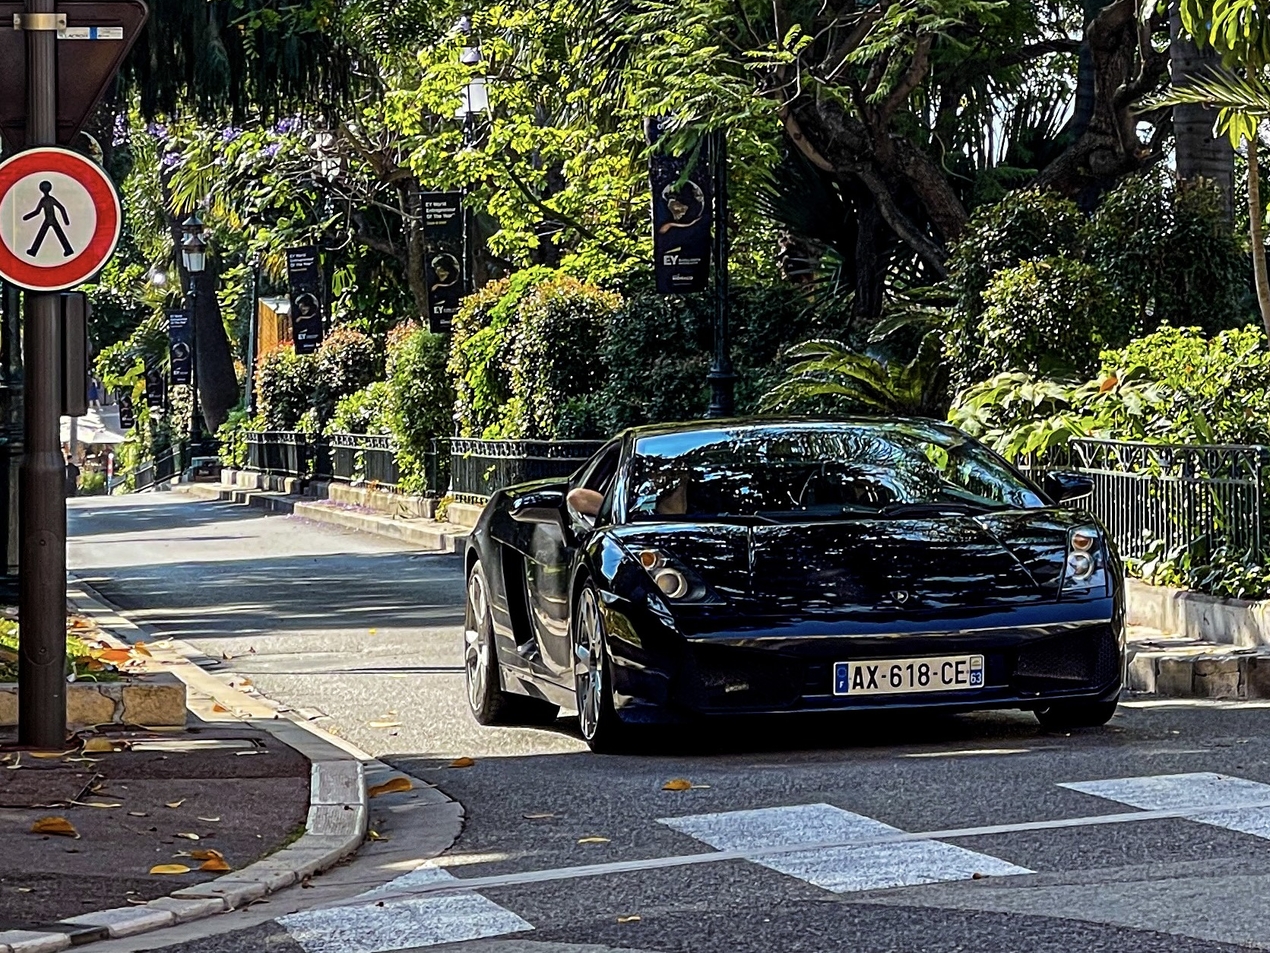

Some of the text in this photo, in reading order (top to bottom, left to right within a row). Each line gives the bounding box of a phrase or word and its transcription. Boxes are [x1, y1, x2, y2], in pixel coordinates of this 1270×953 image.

[663, 255, 679, 265] EY
[433, 306, 444, 314] EY
[852, 661, 967, 690] AX-618-CE
[970, 672, 982, 684] 63
[839, 680, 845, 689] F
